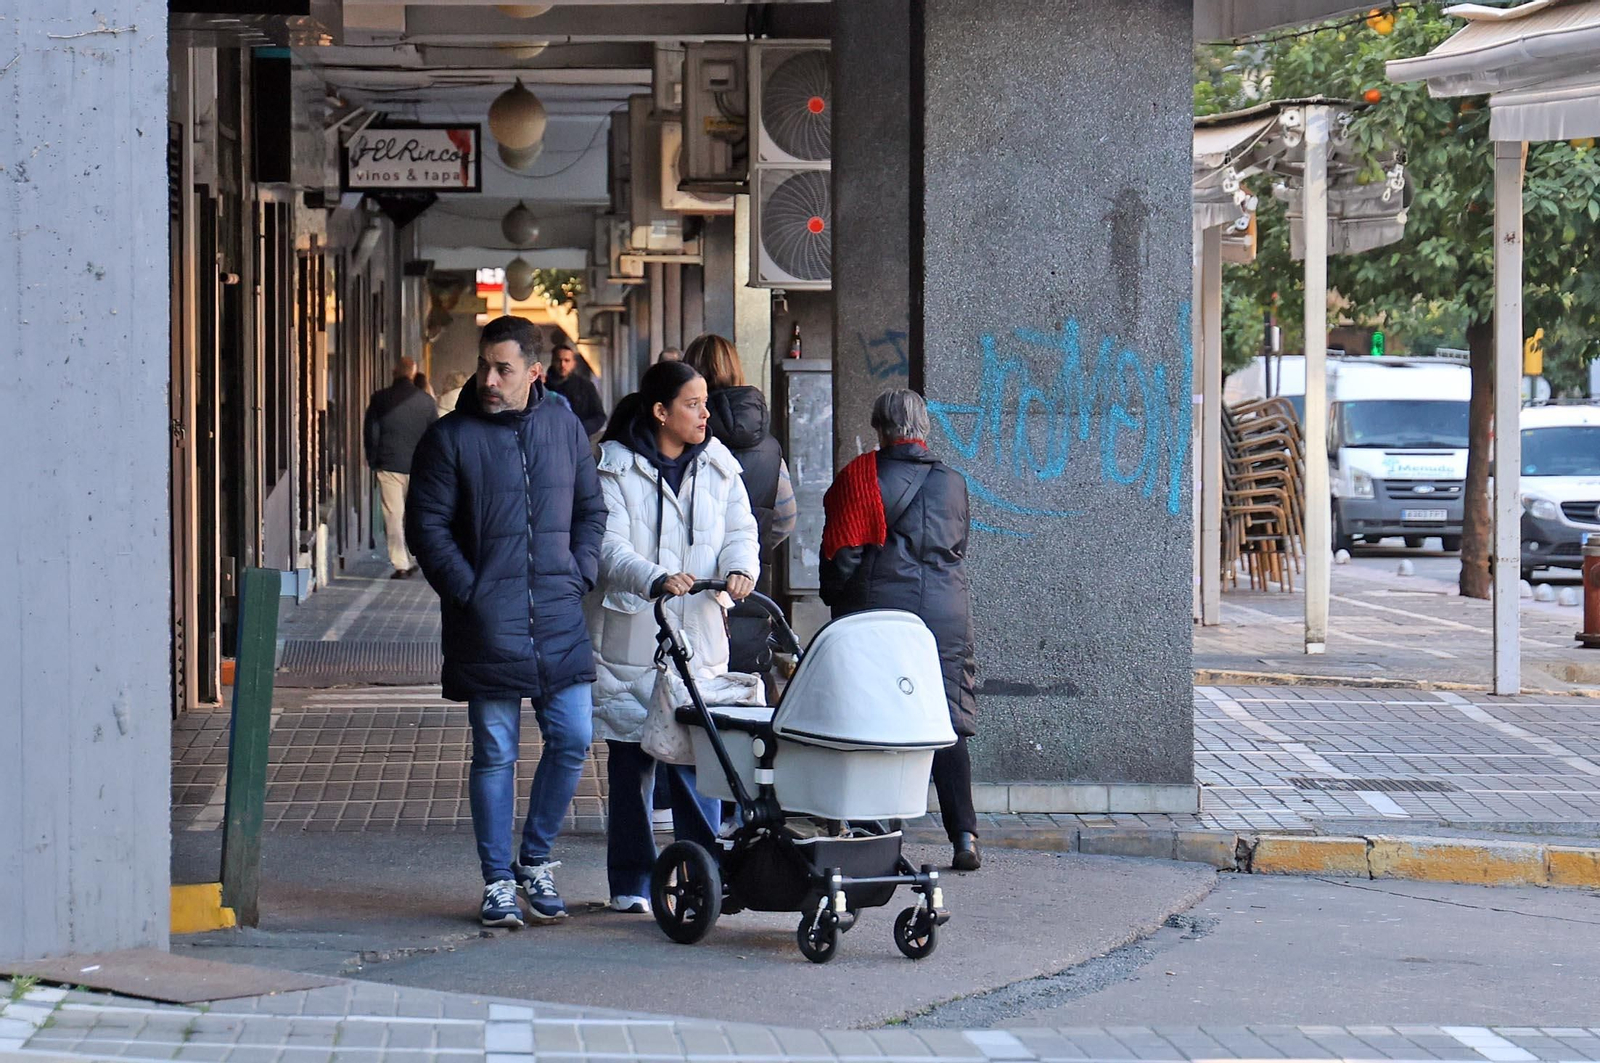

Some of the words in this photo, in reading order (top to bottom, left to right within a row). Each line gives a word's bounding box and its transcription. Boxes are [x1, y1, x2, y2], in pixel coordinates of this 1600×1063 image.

[371, 137, 399, 162] El
[399, 138, 474, 163] Rinco
[356, 169, 400, 181] vinos
[406, 167, 418, 181] &
[424, 169, 461, 183] tapa
